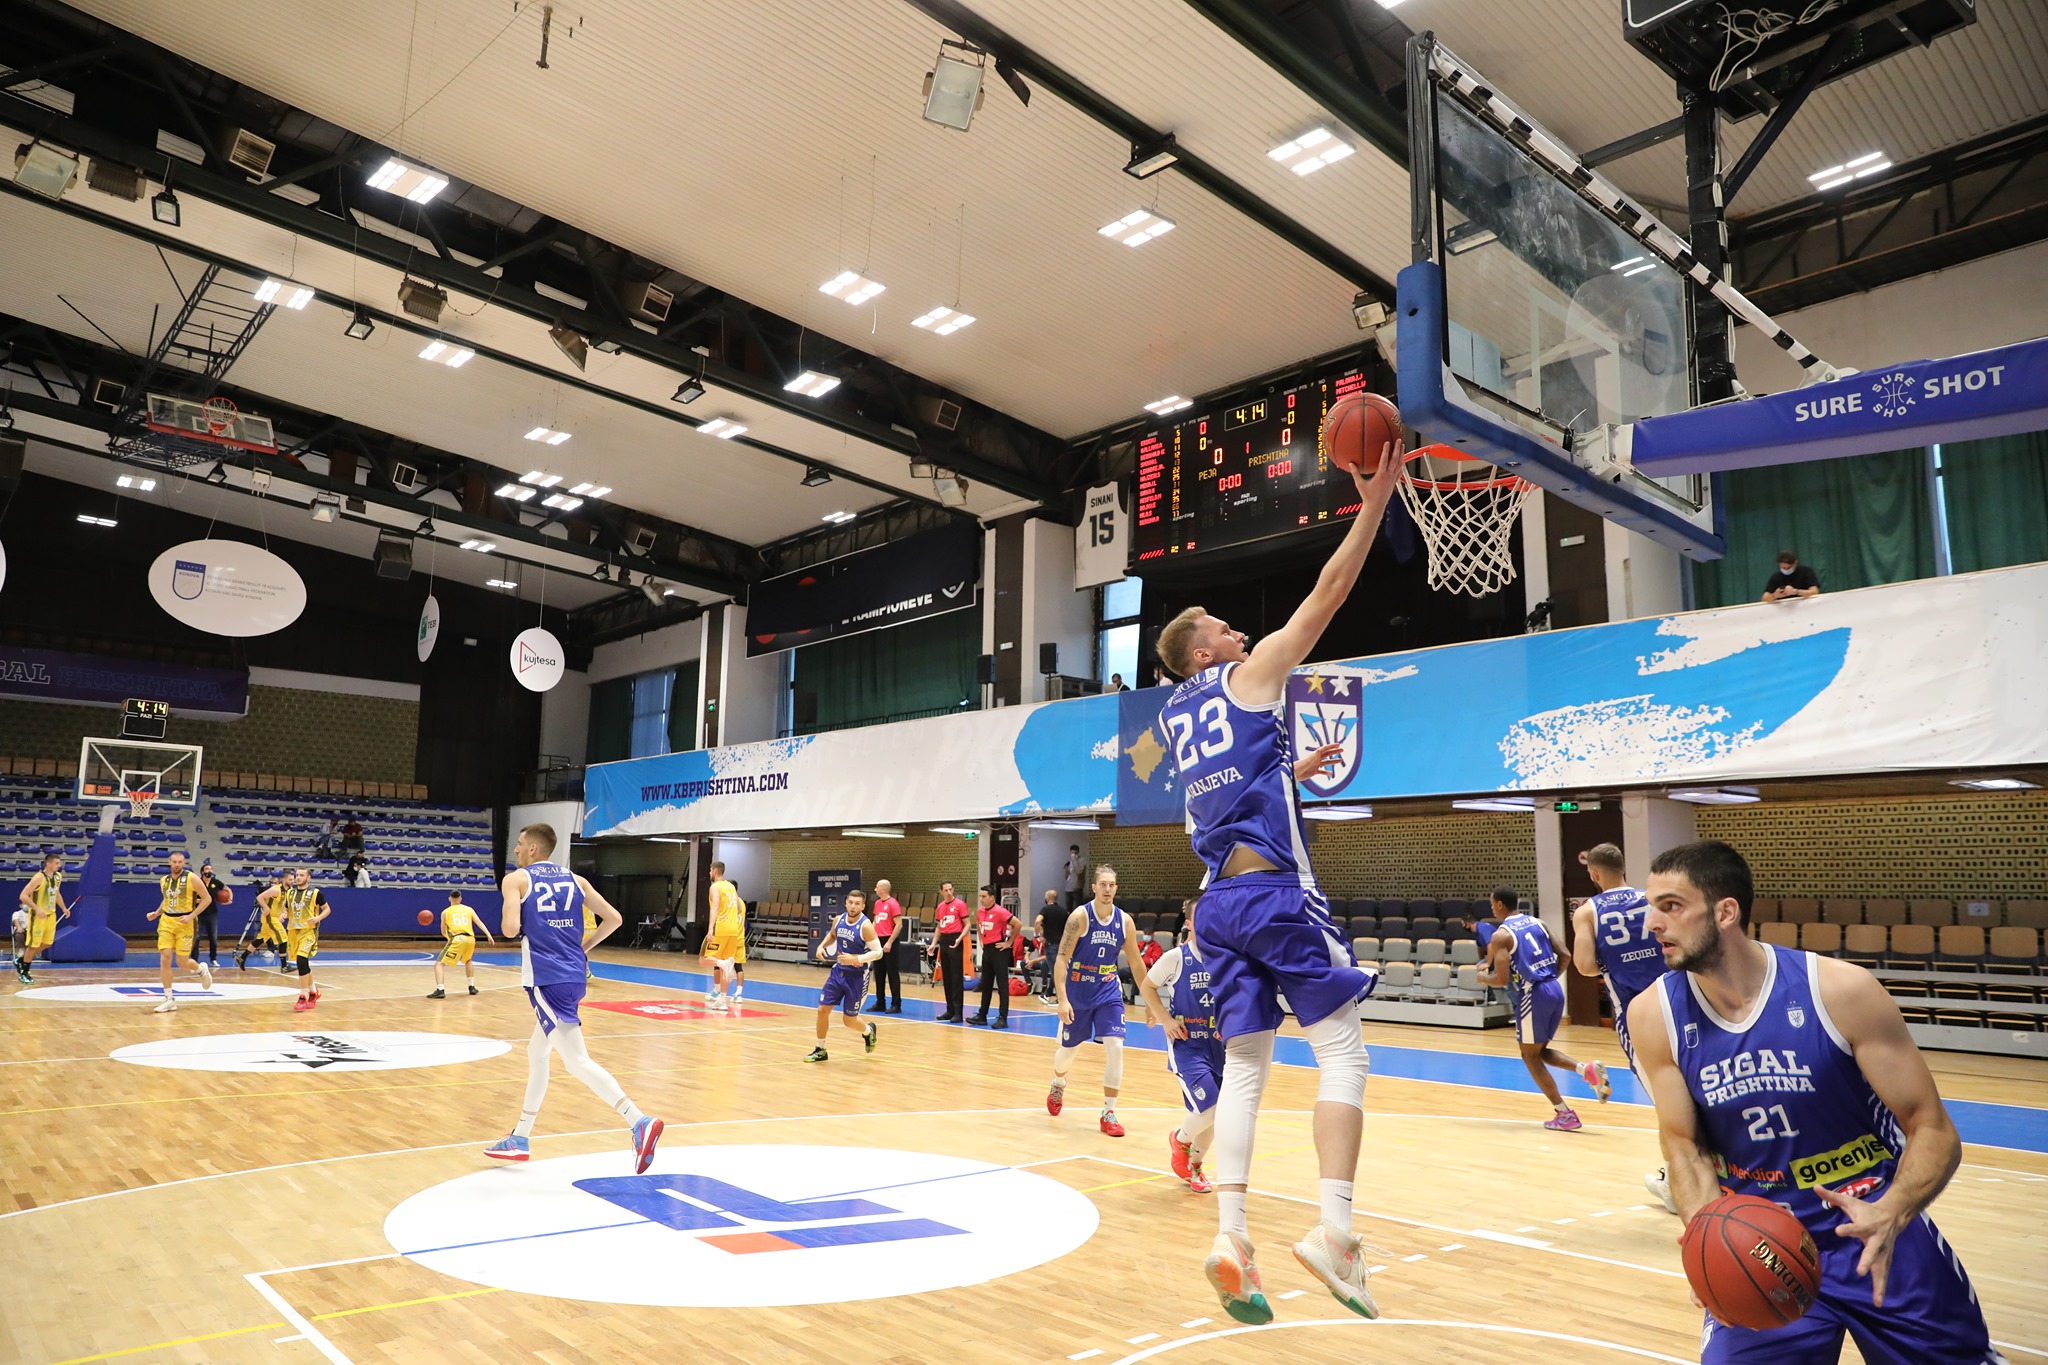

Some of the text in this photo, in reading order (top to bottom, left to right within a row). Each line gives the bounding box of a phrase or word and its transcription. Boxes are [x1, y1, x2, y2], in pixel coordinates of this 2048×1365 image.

[1872, 373, 1915, 393] SURE
[1796, 366, 2005, 422] SURE SHOT
[1236, 403, 1264, 423] 4:14
[1873, 399, 1916, 418] SHOT
[1248, 448, 1289, 467] PRISHTINA
[1199, 468, 1217, 480] PEJA
[1090, 493, 1113, 508] SINANI
[1089, 510, 1114, 548] 15
[428, 620, 437, 629] TEB
[524, 654, 556, 669] kujtesa
[58, 666, 224, 700] PRISHTINA
[137, 701, 166, 714] 4:14
[1167, 697, 1233, 772] 23
[641, 772, 789, 801] WWW.KBPRISHTINA.COM
[534, 882, 575, 912] 27
[453, 912, 468, 926] 66
[1600, 904, 1651, 946] 37
[1092, 931, 1117, 941] SIGAL
[1525, 932, 1542, 956] 1
[1098, 947, 1105, 957] 0
[1621, 948, 1657, 962] ZEQIRI
[1190, 982, 1208, 990] PRIS
[854, 1001, 860, 1009] 5
[1700, 1050, 1812, 1091] SIGAL
[1705, 1076, 1816, 1107] PRISHTINA
[1742, 1104, 1799, 1142] 21
[1728, 1163, 1785, 1180] Meridian
[1800, 1140, 1885, 1183] gorenje
[1750, 1239, 1810, 1310] ALDING
